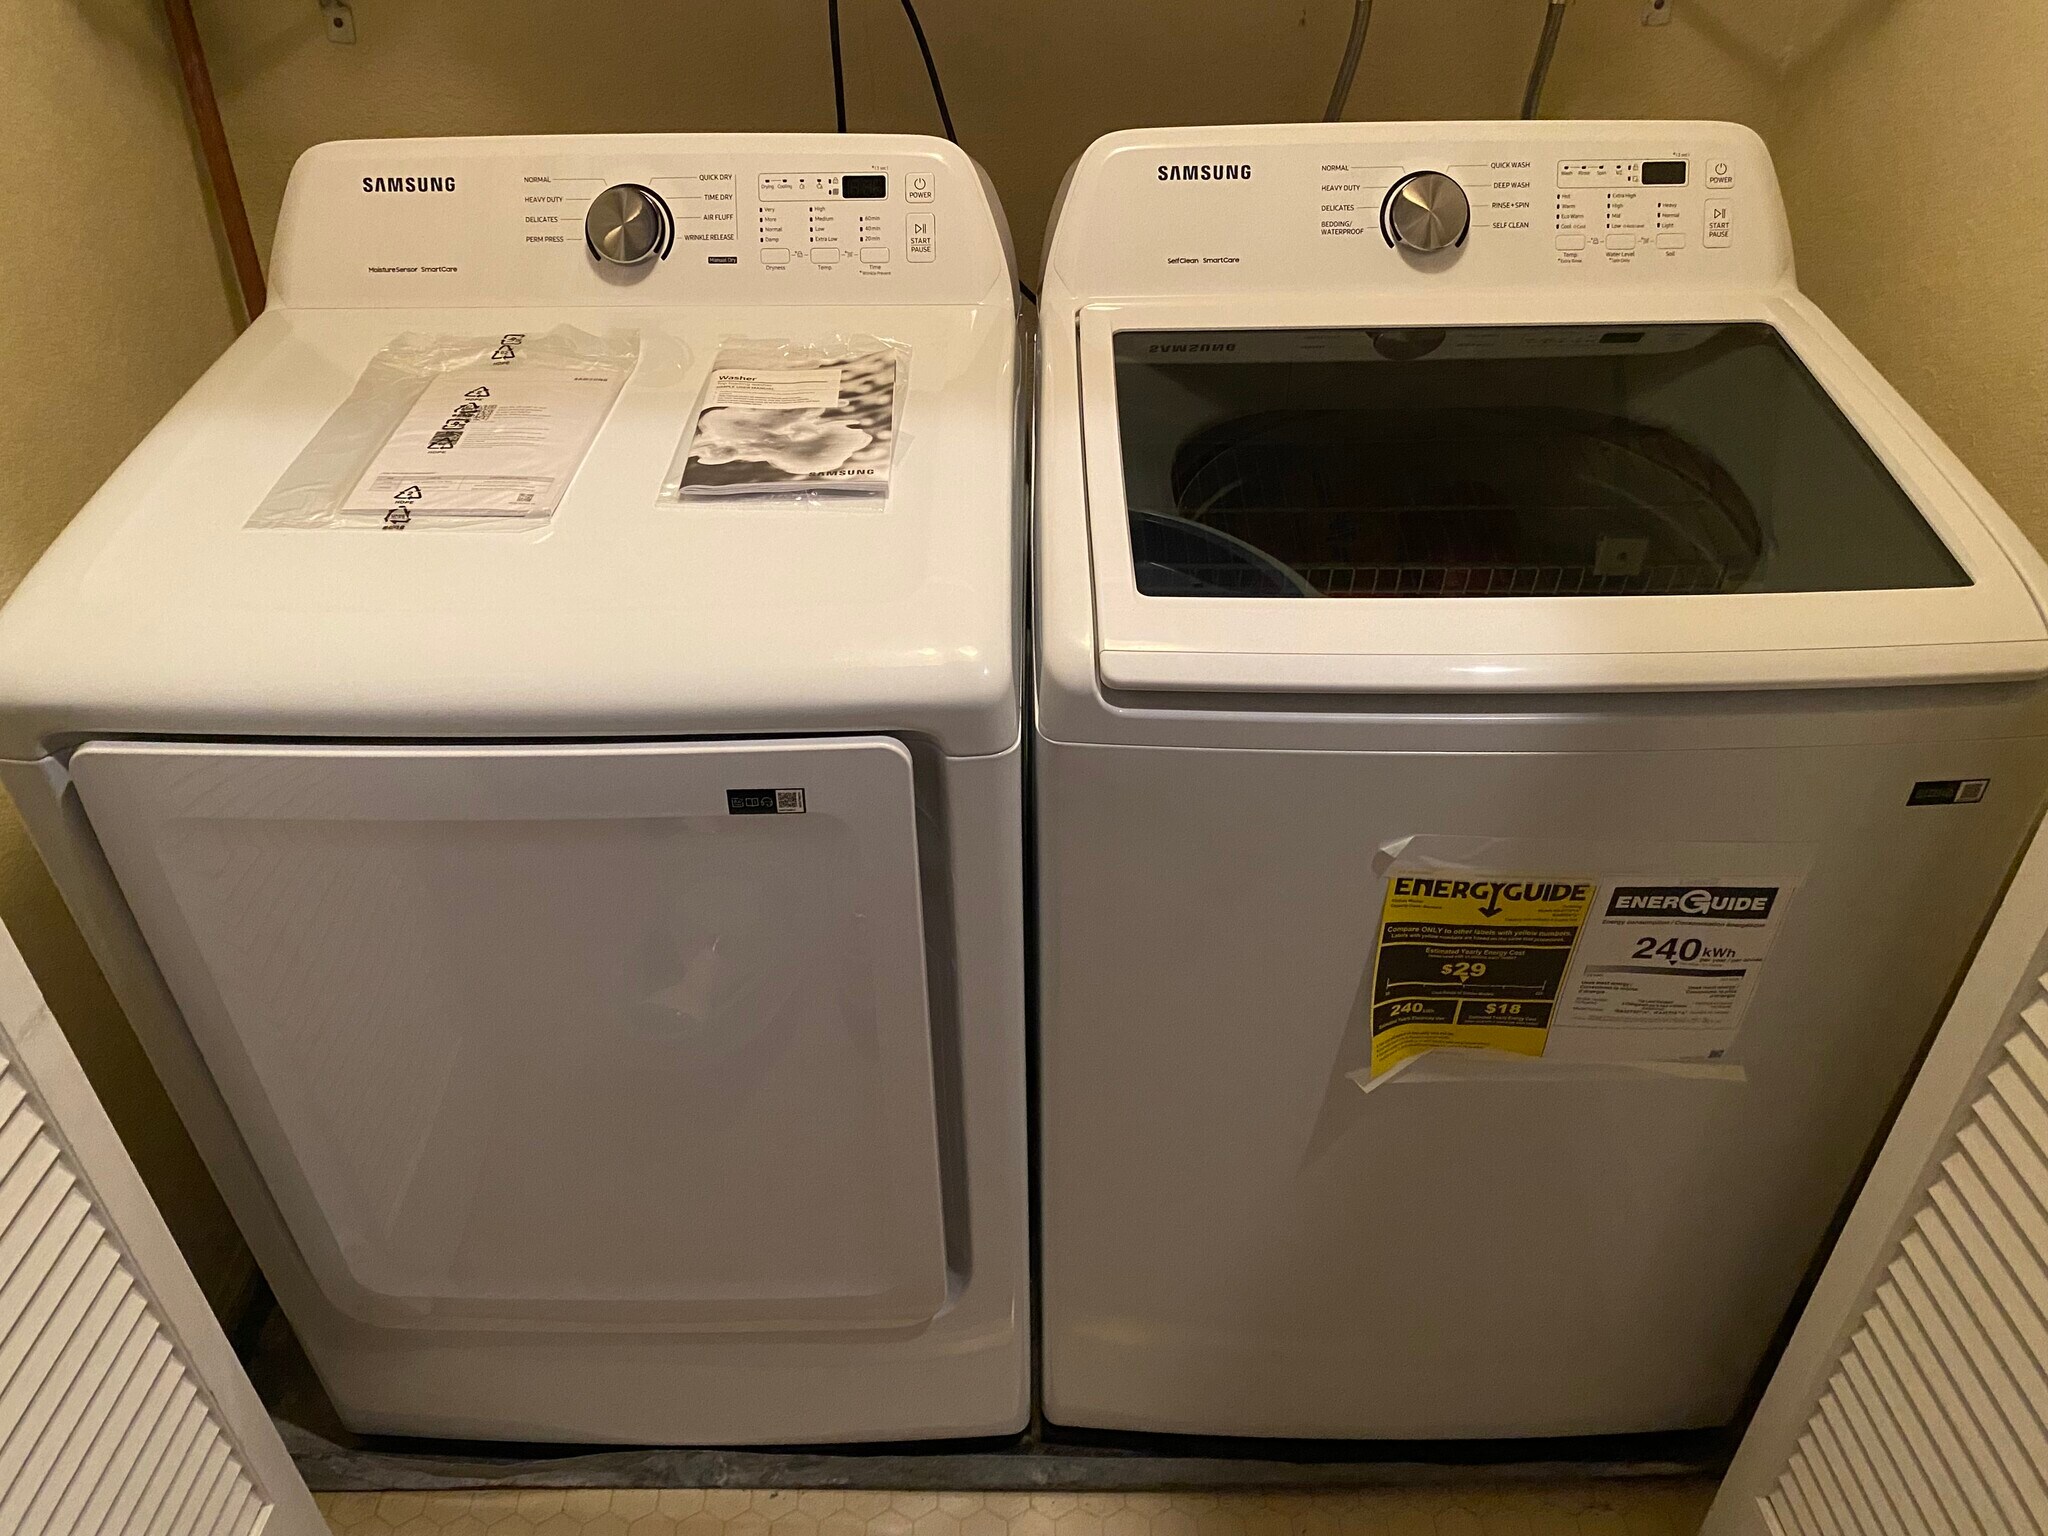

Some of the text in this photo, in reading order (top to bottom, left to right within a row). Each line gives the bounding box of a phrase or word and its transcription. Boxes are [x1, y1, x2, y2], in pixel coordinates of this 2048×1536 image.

[1158, 165, 1251, 180] SAMSUNG
[363, 177, 455, 192] SAMSUNG
[809, 468, 875, 477] SAMSUNG
[1394, 877, 1590, 902] ENERGYGUIDE
[1632, 937, 1736, 961] 240 kWh
[1441, 962, 1486, 977] $29
[1390, 1003, 1423, 1016] 240
[1485, 1004, 1521, 1014] $18
